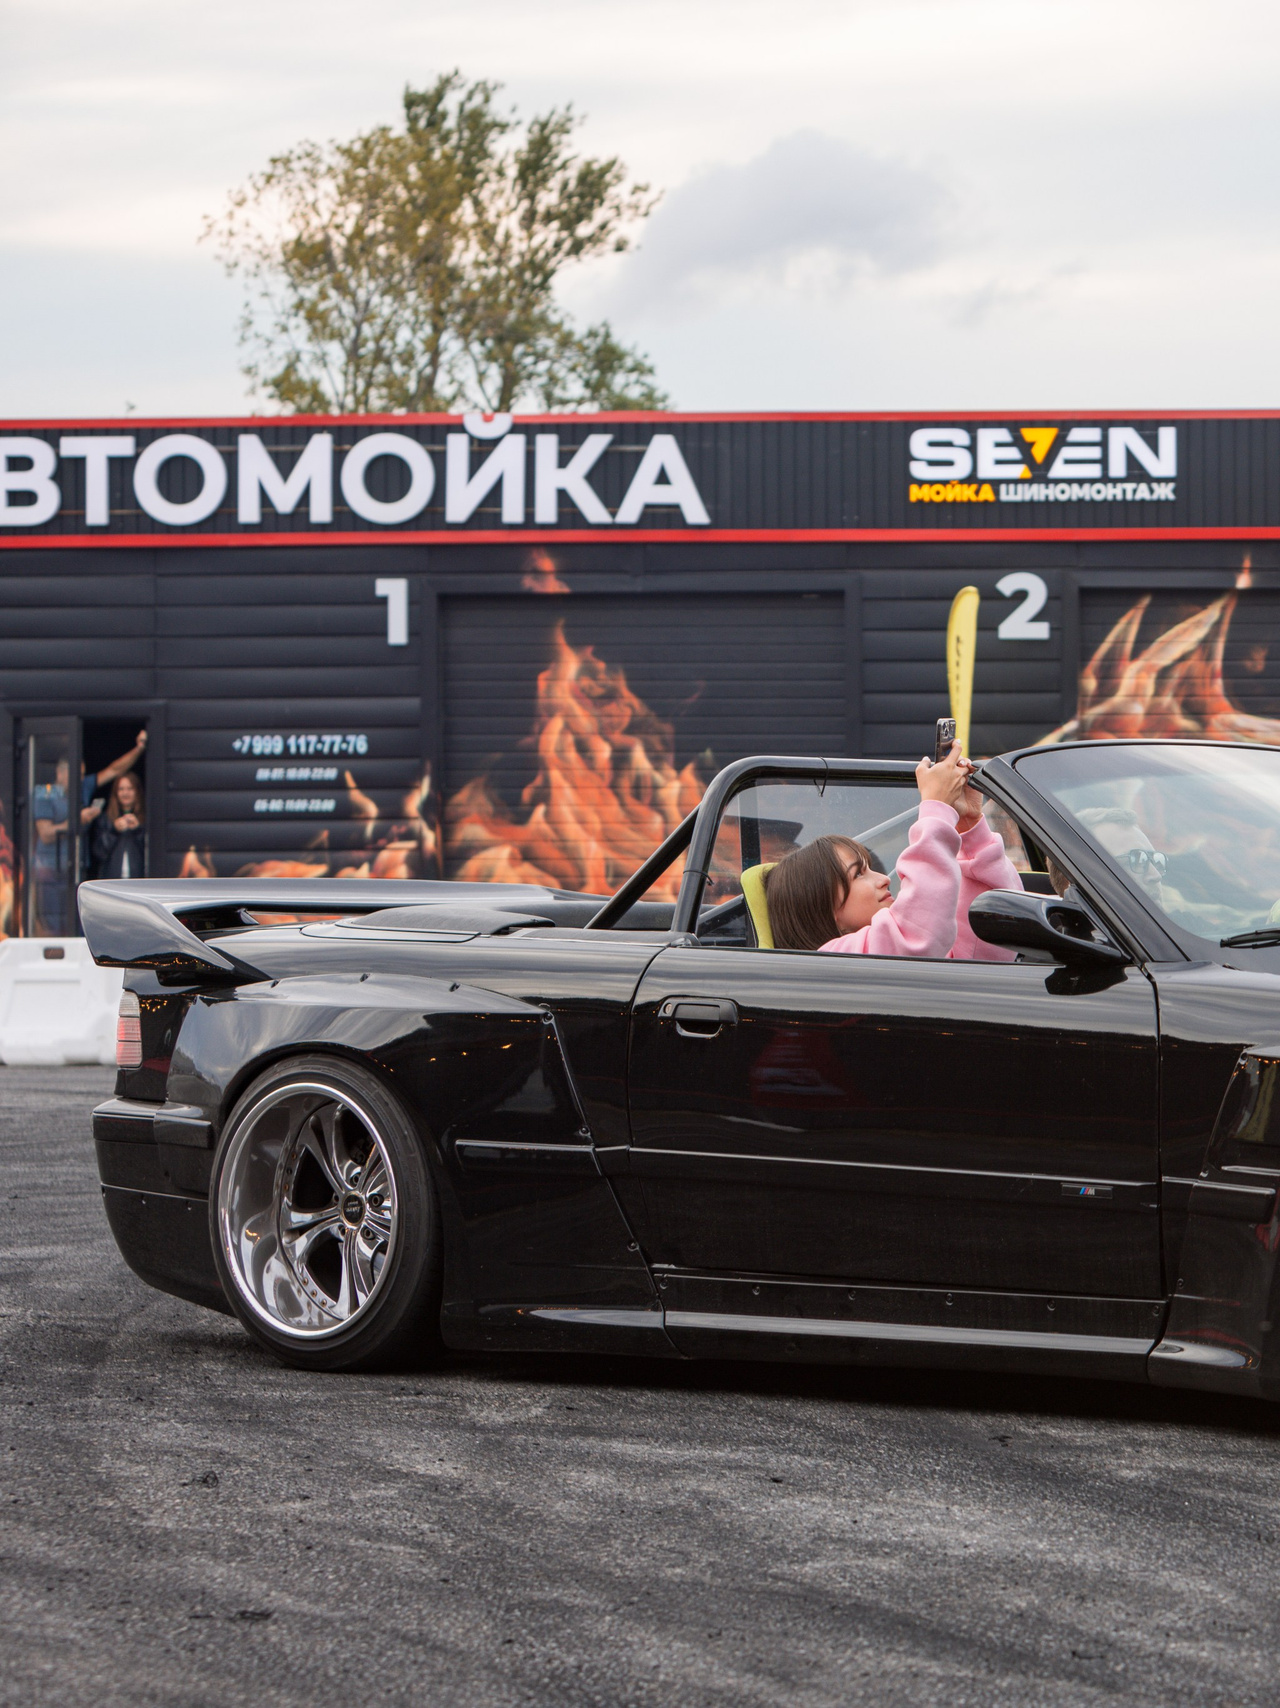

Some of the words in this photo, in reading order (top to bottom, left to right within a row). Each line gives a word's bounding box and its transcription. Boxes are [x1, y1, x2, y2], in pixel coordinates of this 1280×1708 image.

[909, 480, 996, 502] МОЙКА
[999, 482, 1177, 502] ШИНОМОНТАЖ
[375, 577, 408, 645] 1
[995, 571, 1050, 640] 2
